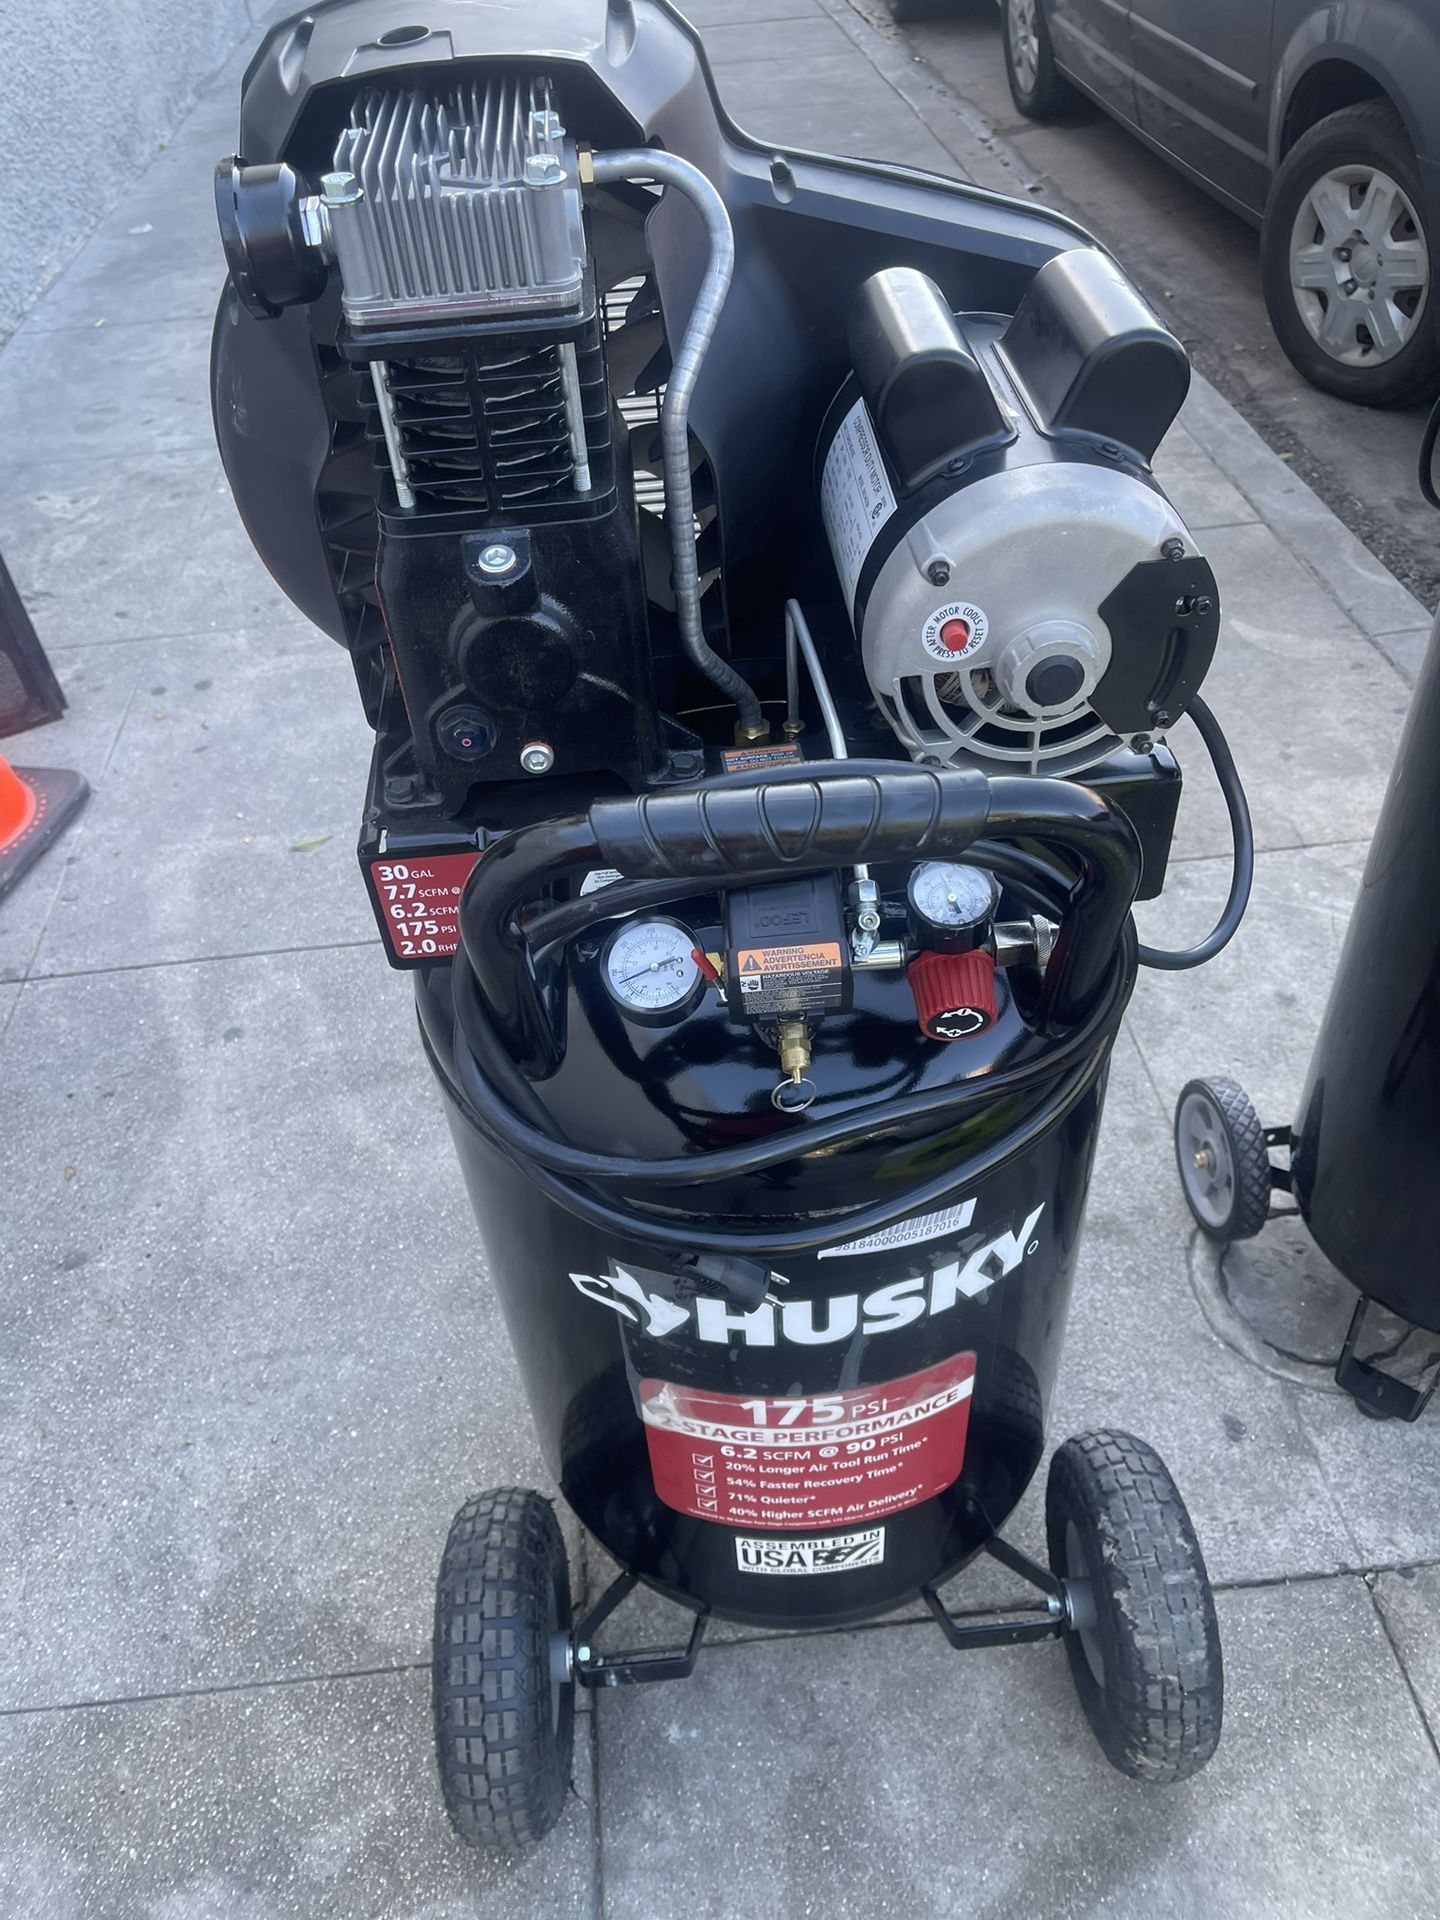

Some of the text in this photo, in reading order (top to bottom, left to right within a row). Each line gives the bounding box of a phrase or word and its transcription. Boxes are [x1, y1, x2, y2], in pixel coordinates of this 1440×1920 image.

[926, 606, 983, 646] AFTER MOTOR COOLS
[932, 628, 985, 659] PRESS TO RESET
[378, 864, 435, 882] 30 GAL
[383, 883, 461, 900] 7.7 SCFM @
[390, 902, 459, 919] 6.2 SCFM
[396, 920, 457, 937] 175 PSI
[400, 938, 437, 956] 2.0
[762, 947, 805, 957] WARNING
[763, 952, 826, 964] ADVERTENCIA
[763, 958, 837, 972] AVERTISSEMENT
[696, 1201, 1046, 1347] HUSKY
[661, 1388, 959, 1443] 2-STAGE PERFORMANCE
[740, 1395, 888, 1426] 175 PSI
[720, 1432, 904, 1461] 6.2 SCFM @ 90 PSI
[725, 1461, 756, 1472] 20%
[759, 1465, 806, 1475] Longer
[808, 1463, 829, 1472] Air
[832, 1457, 861, 1470] Tool
[864, 1452, 889, 1464] Run
[726, 1477, 757, 1488] 54%
[760, 1480, 801, 1489] Faster
[803, 1474, 863, 1489] Recovery
[728, 1492, 758, 1503] 71%
[729, 1507, 758, 1517] 40%
[761, 1510, 804, 1520] Higher
[807, 1506, 844, 1518] SCFM
[846, 1503, 865, 1513] Air
[740, 1530, 880, 1551] ASSEMBLED IN
[742, 1548, 807, 1568] USA
[742, 1556, 880, 1574] WITH GLOBAL COMPONENTS
